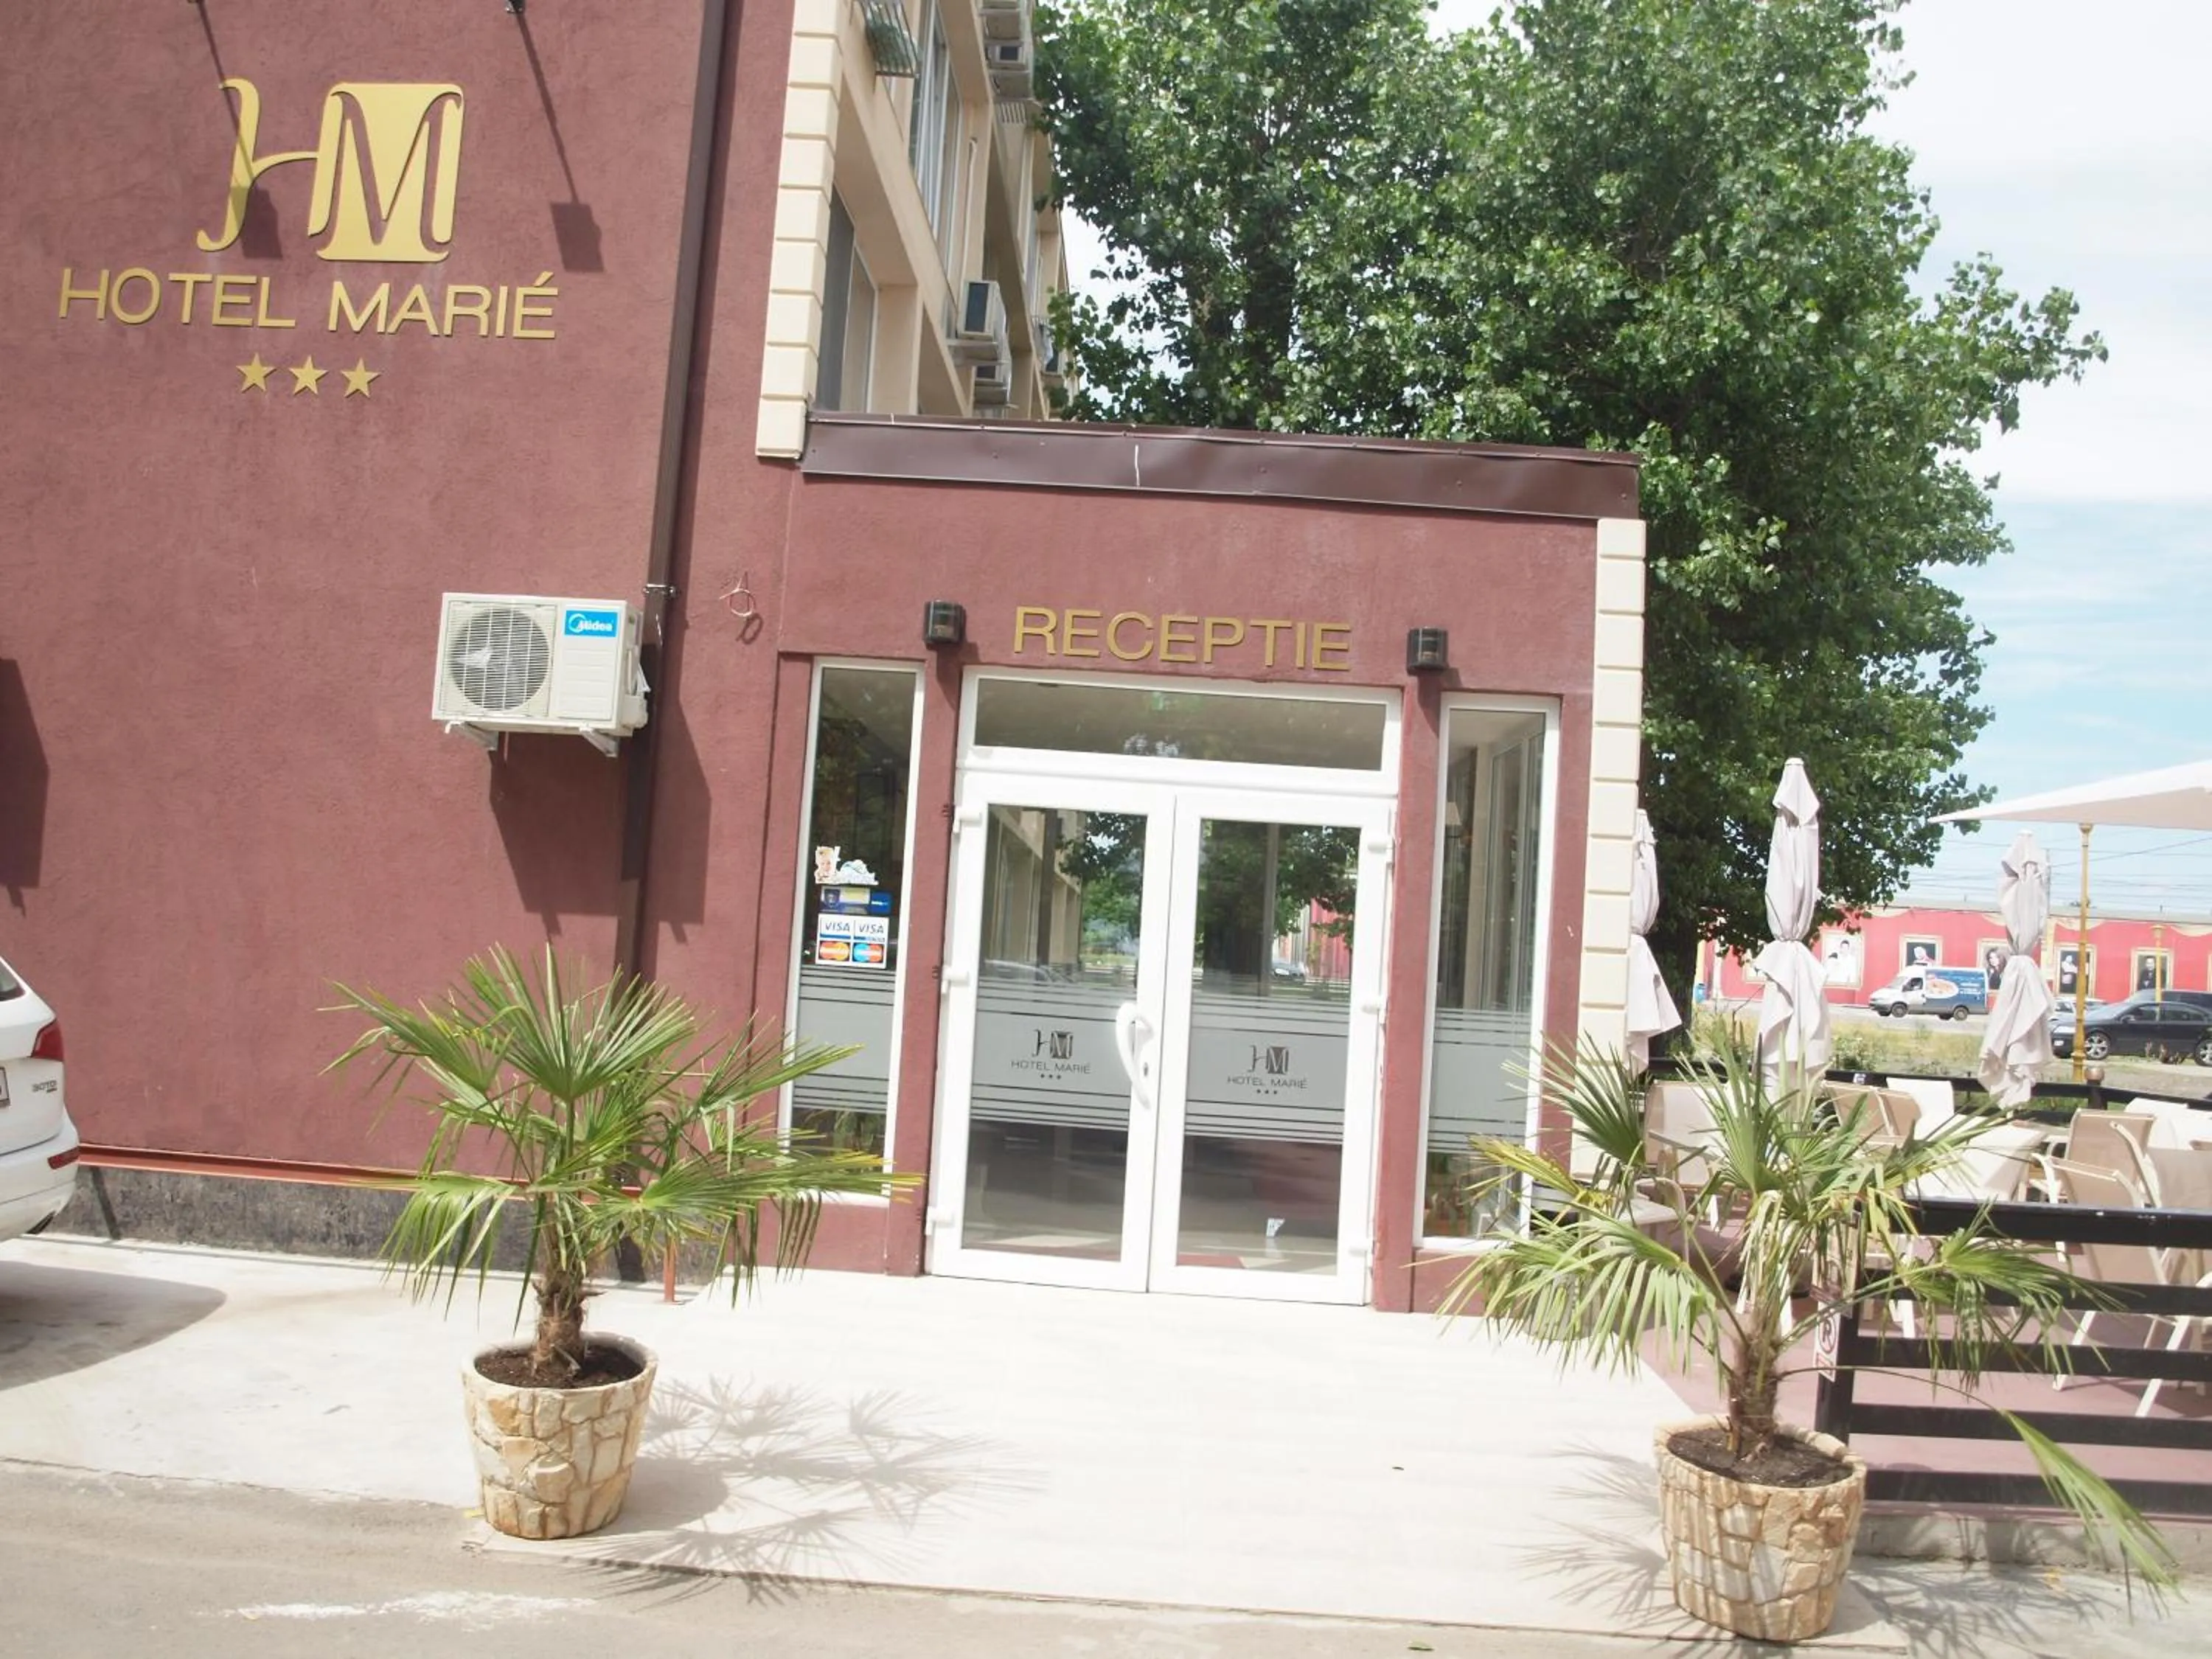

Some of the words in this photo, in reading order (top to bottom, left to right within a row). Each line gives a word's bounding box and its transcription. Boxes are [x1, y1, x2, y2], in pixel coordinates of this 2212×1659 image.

[59, 268, 296, 327] HOTEL
[328, 271, 558, 338] MARIÉ
[577, 619, 613, 632] Midea
[1014, 606, 1351, 671] RECEPTIE
[825, 922, 850, 932] VISA
[859, 923, 884, 933] VISA
[1011, 1060, 1051, 1071] HOTEL
[1227, 1076, 1265, 1086] HOTEL
